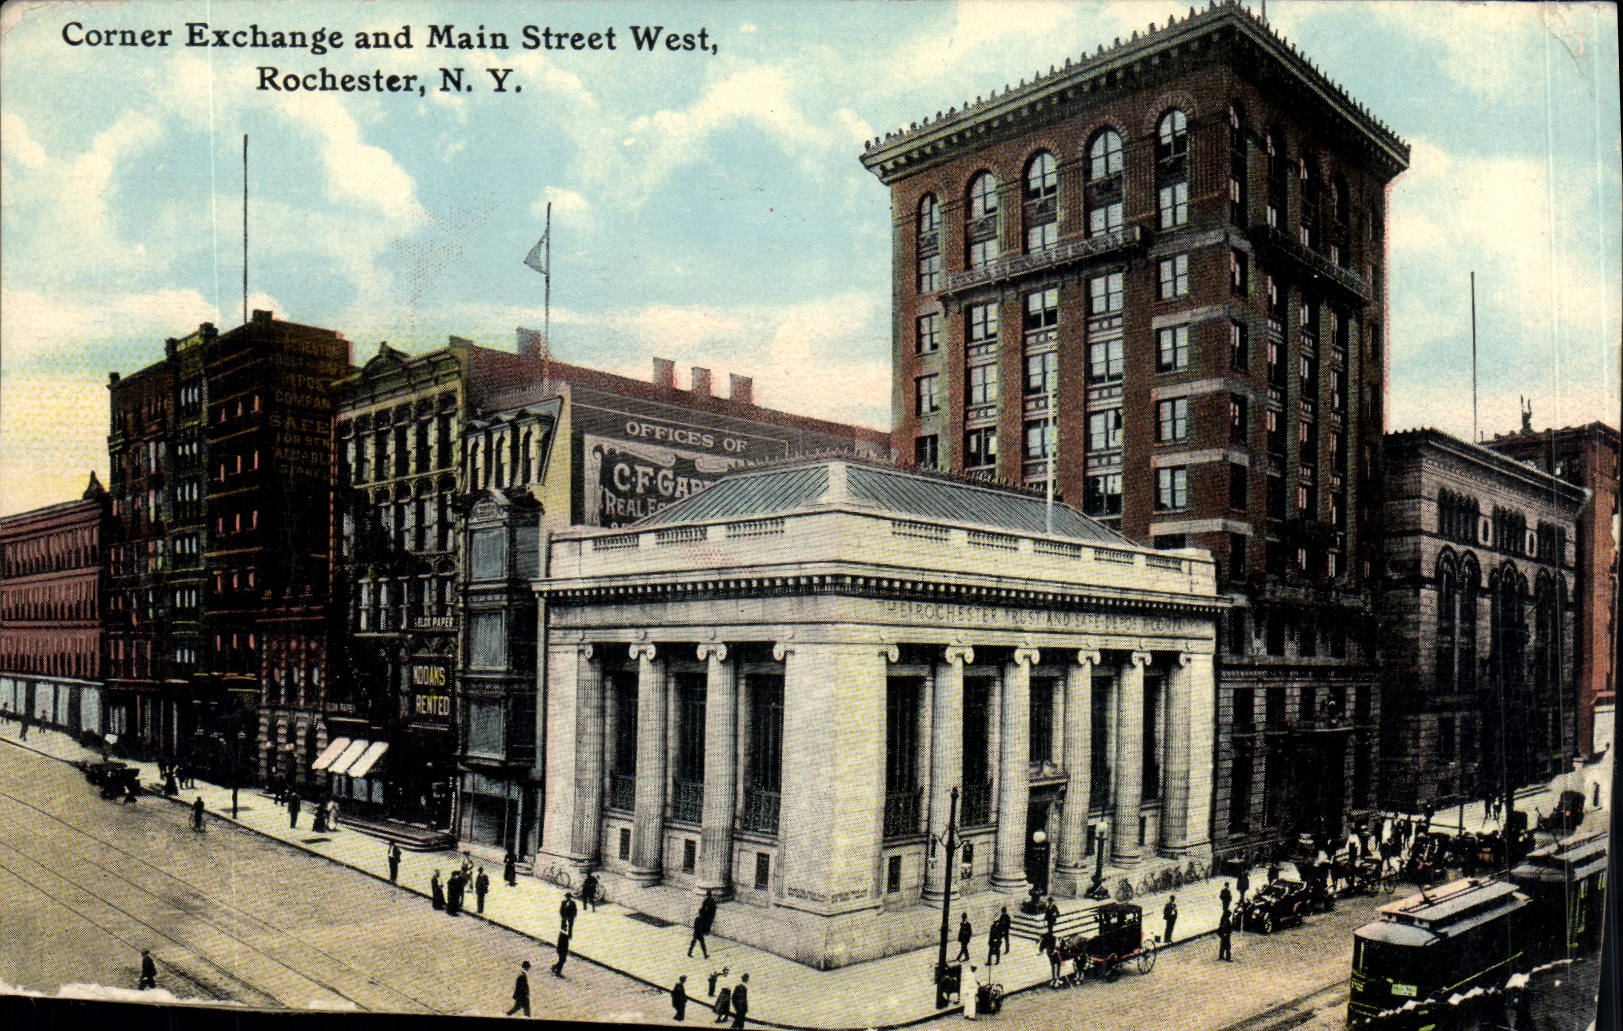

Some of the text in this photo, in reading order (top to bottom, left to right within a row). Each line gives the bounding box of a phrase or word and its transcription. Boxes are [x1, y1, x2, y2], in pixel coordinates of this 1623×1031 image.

[626, 420, 748, 452] OFFICES OF
[603, 486, 644, 518] REAL
[434, 616, 455, 629] PAPER
[415, 694, 451, 717] RENTED
